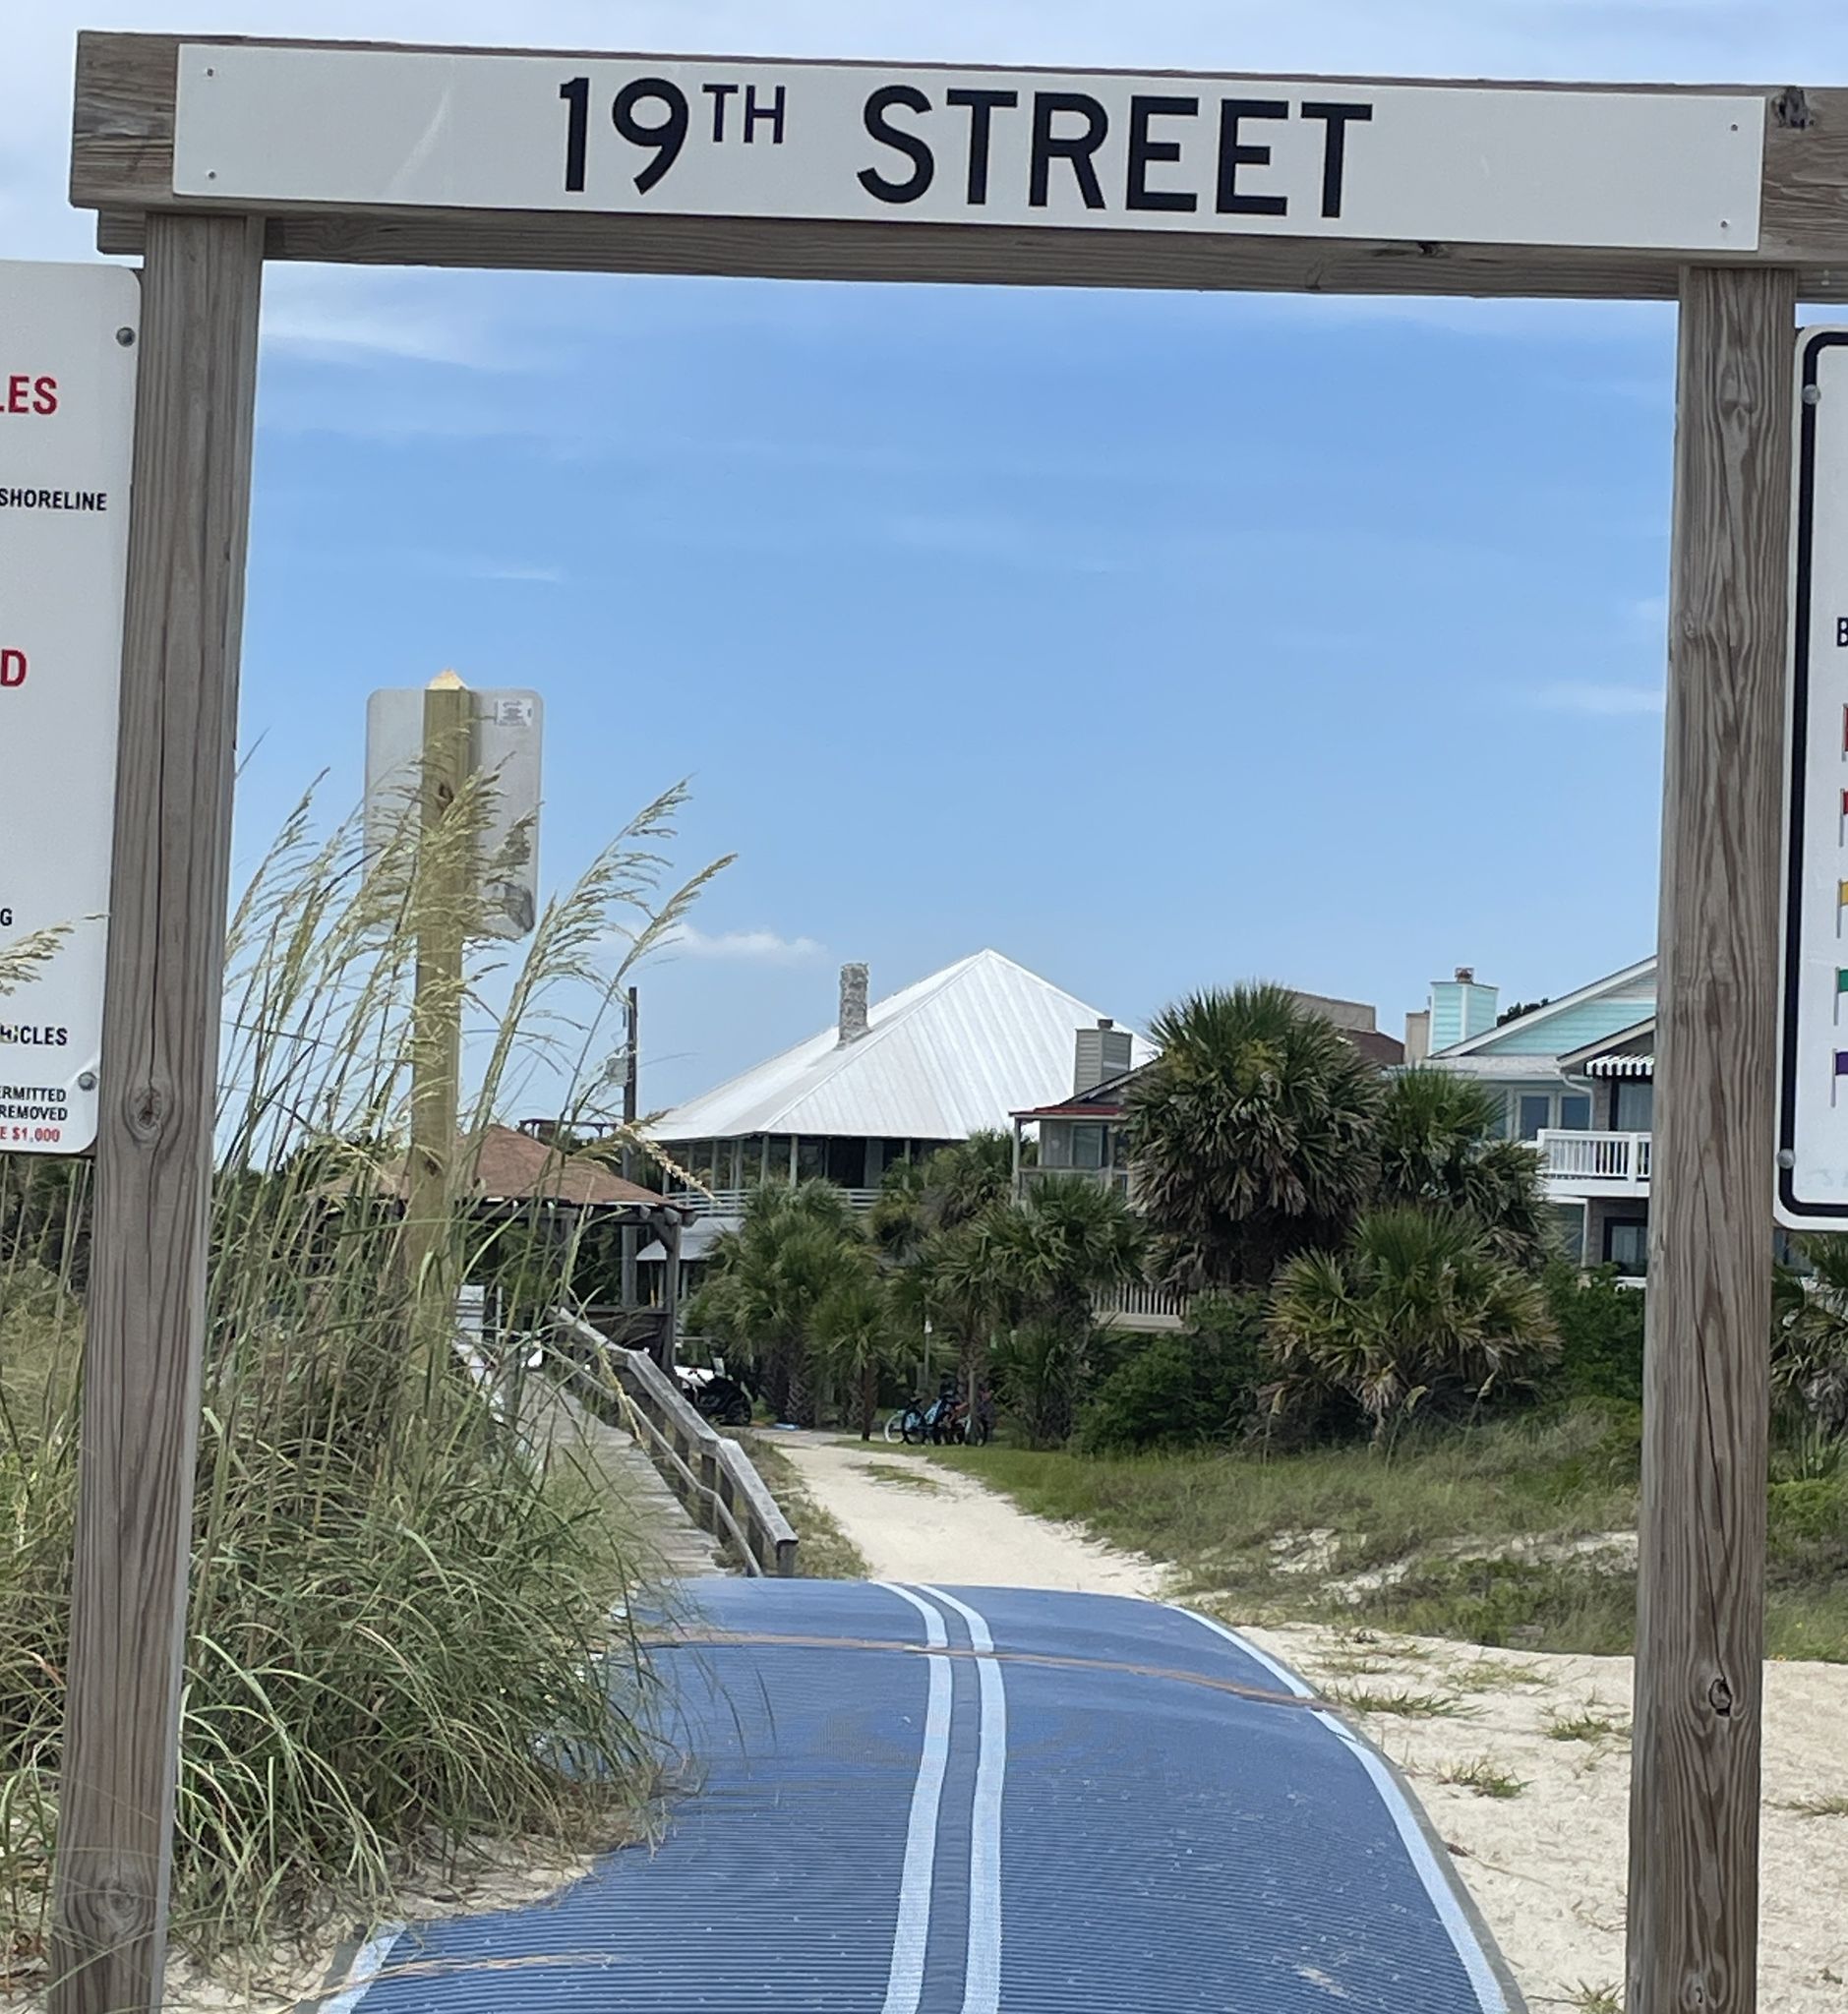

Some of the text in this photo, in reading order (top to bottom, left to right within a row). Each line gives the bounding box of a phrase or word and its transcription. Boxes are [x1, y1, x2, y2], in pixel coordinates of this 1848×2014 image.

[560, 78, 1373, 218] 19TH STREET
[0, 376, 57, 414] ES
[0, 488, 107, 510] SHORELINE
[1, 649, 27, 686] D
[0, 1085, 66, 1101] RMITTED
[0, 1103, 68, 1121] REMOVED
